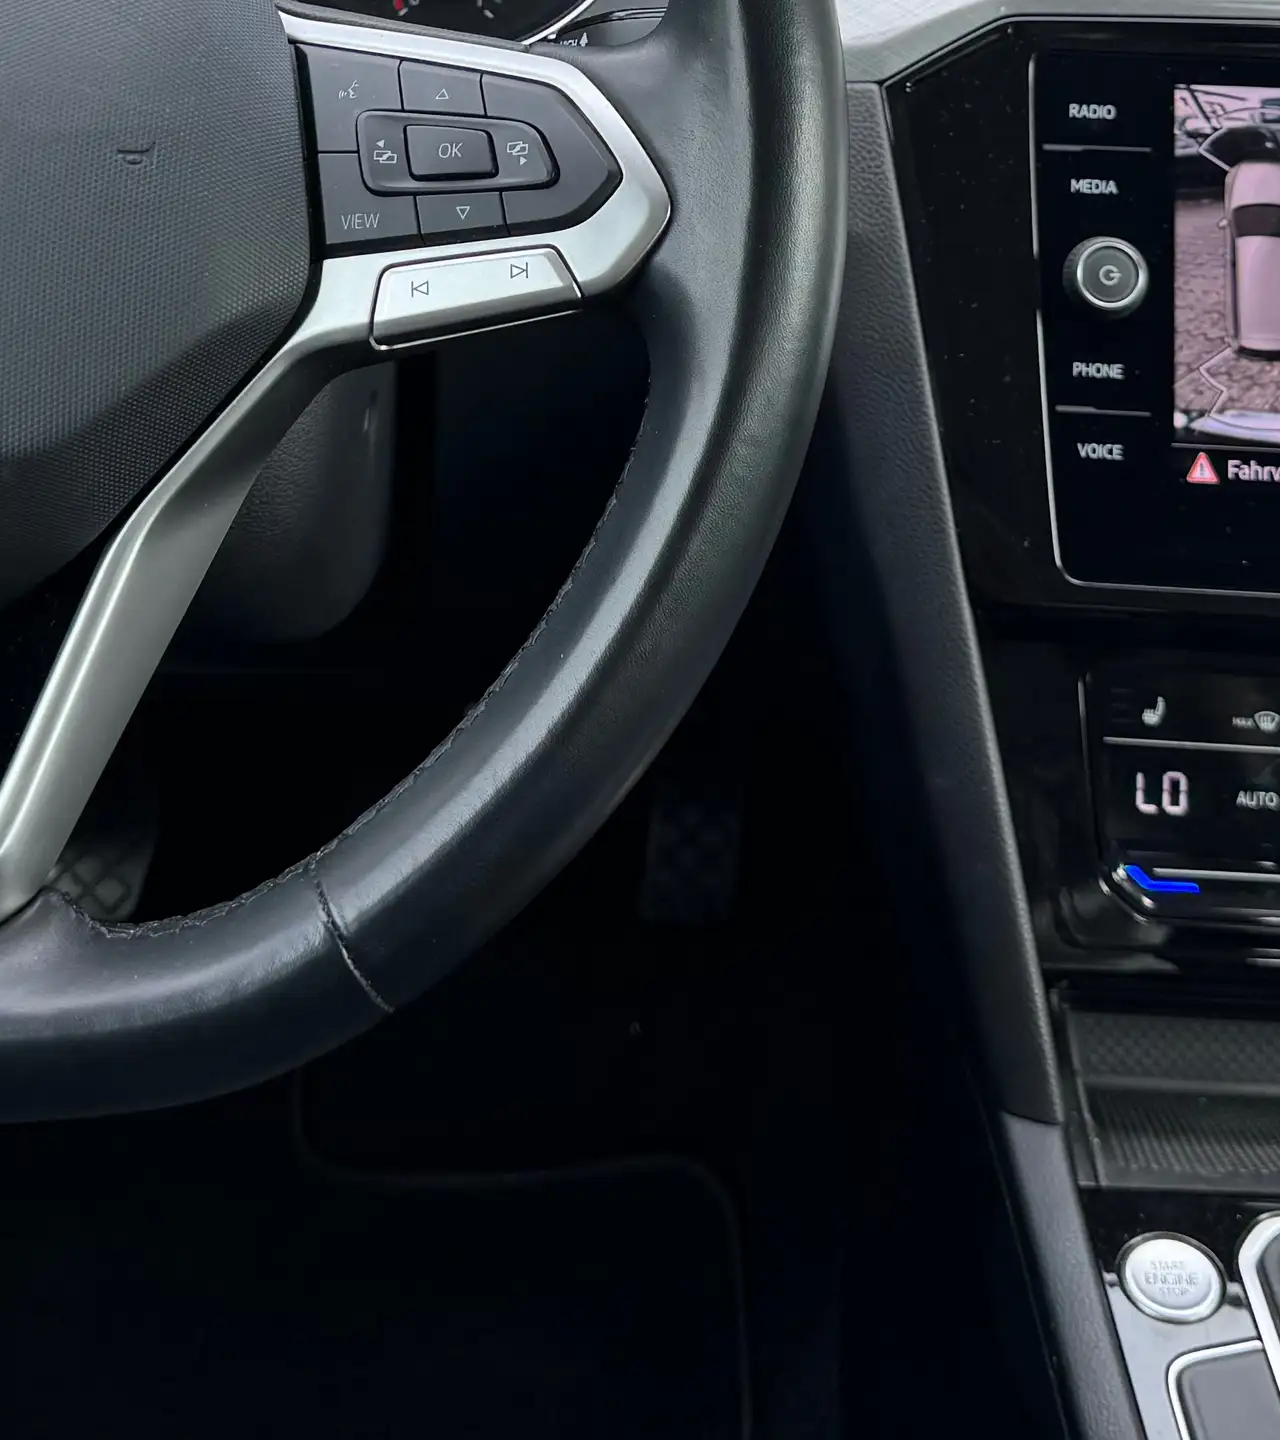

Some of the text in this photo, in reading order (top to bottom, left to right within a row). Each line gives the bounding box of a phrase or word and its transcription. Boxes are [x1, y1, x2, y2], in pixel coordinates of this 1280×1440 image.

[1068, 103, 1117, 121] RADIO
[438, 142, 463, 158] OK
[1070, 178, 1119, 195] MEDIA
[341, 213, 380, 230] VIEW
[1072, 361, 1126, 379] PHONE
[1077, 442, 1125, 461] VOICE
[1134, 770, 1190, 816] LO
[1236, 790, 1280, 811] AUTO
